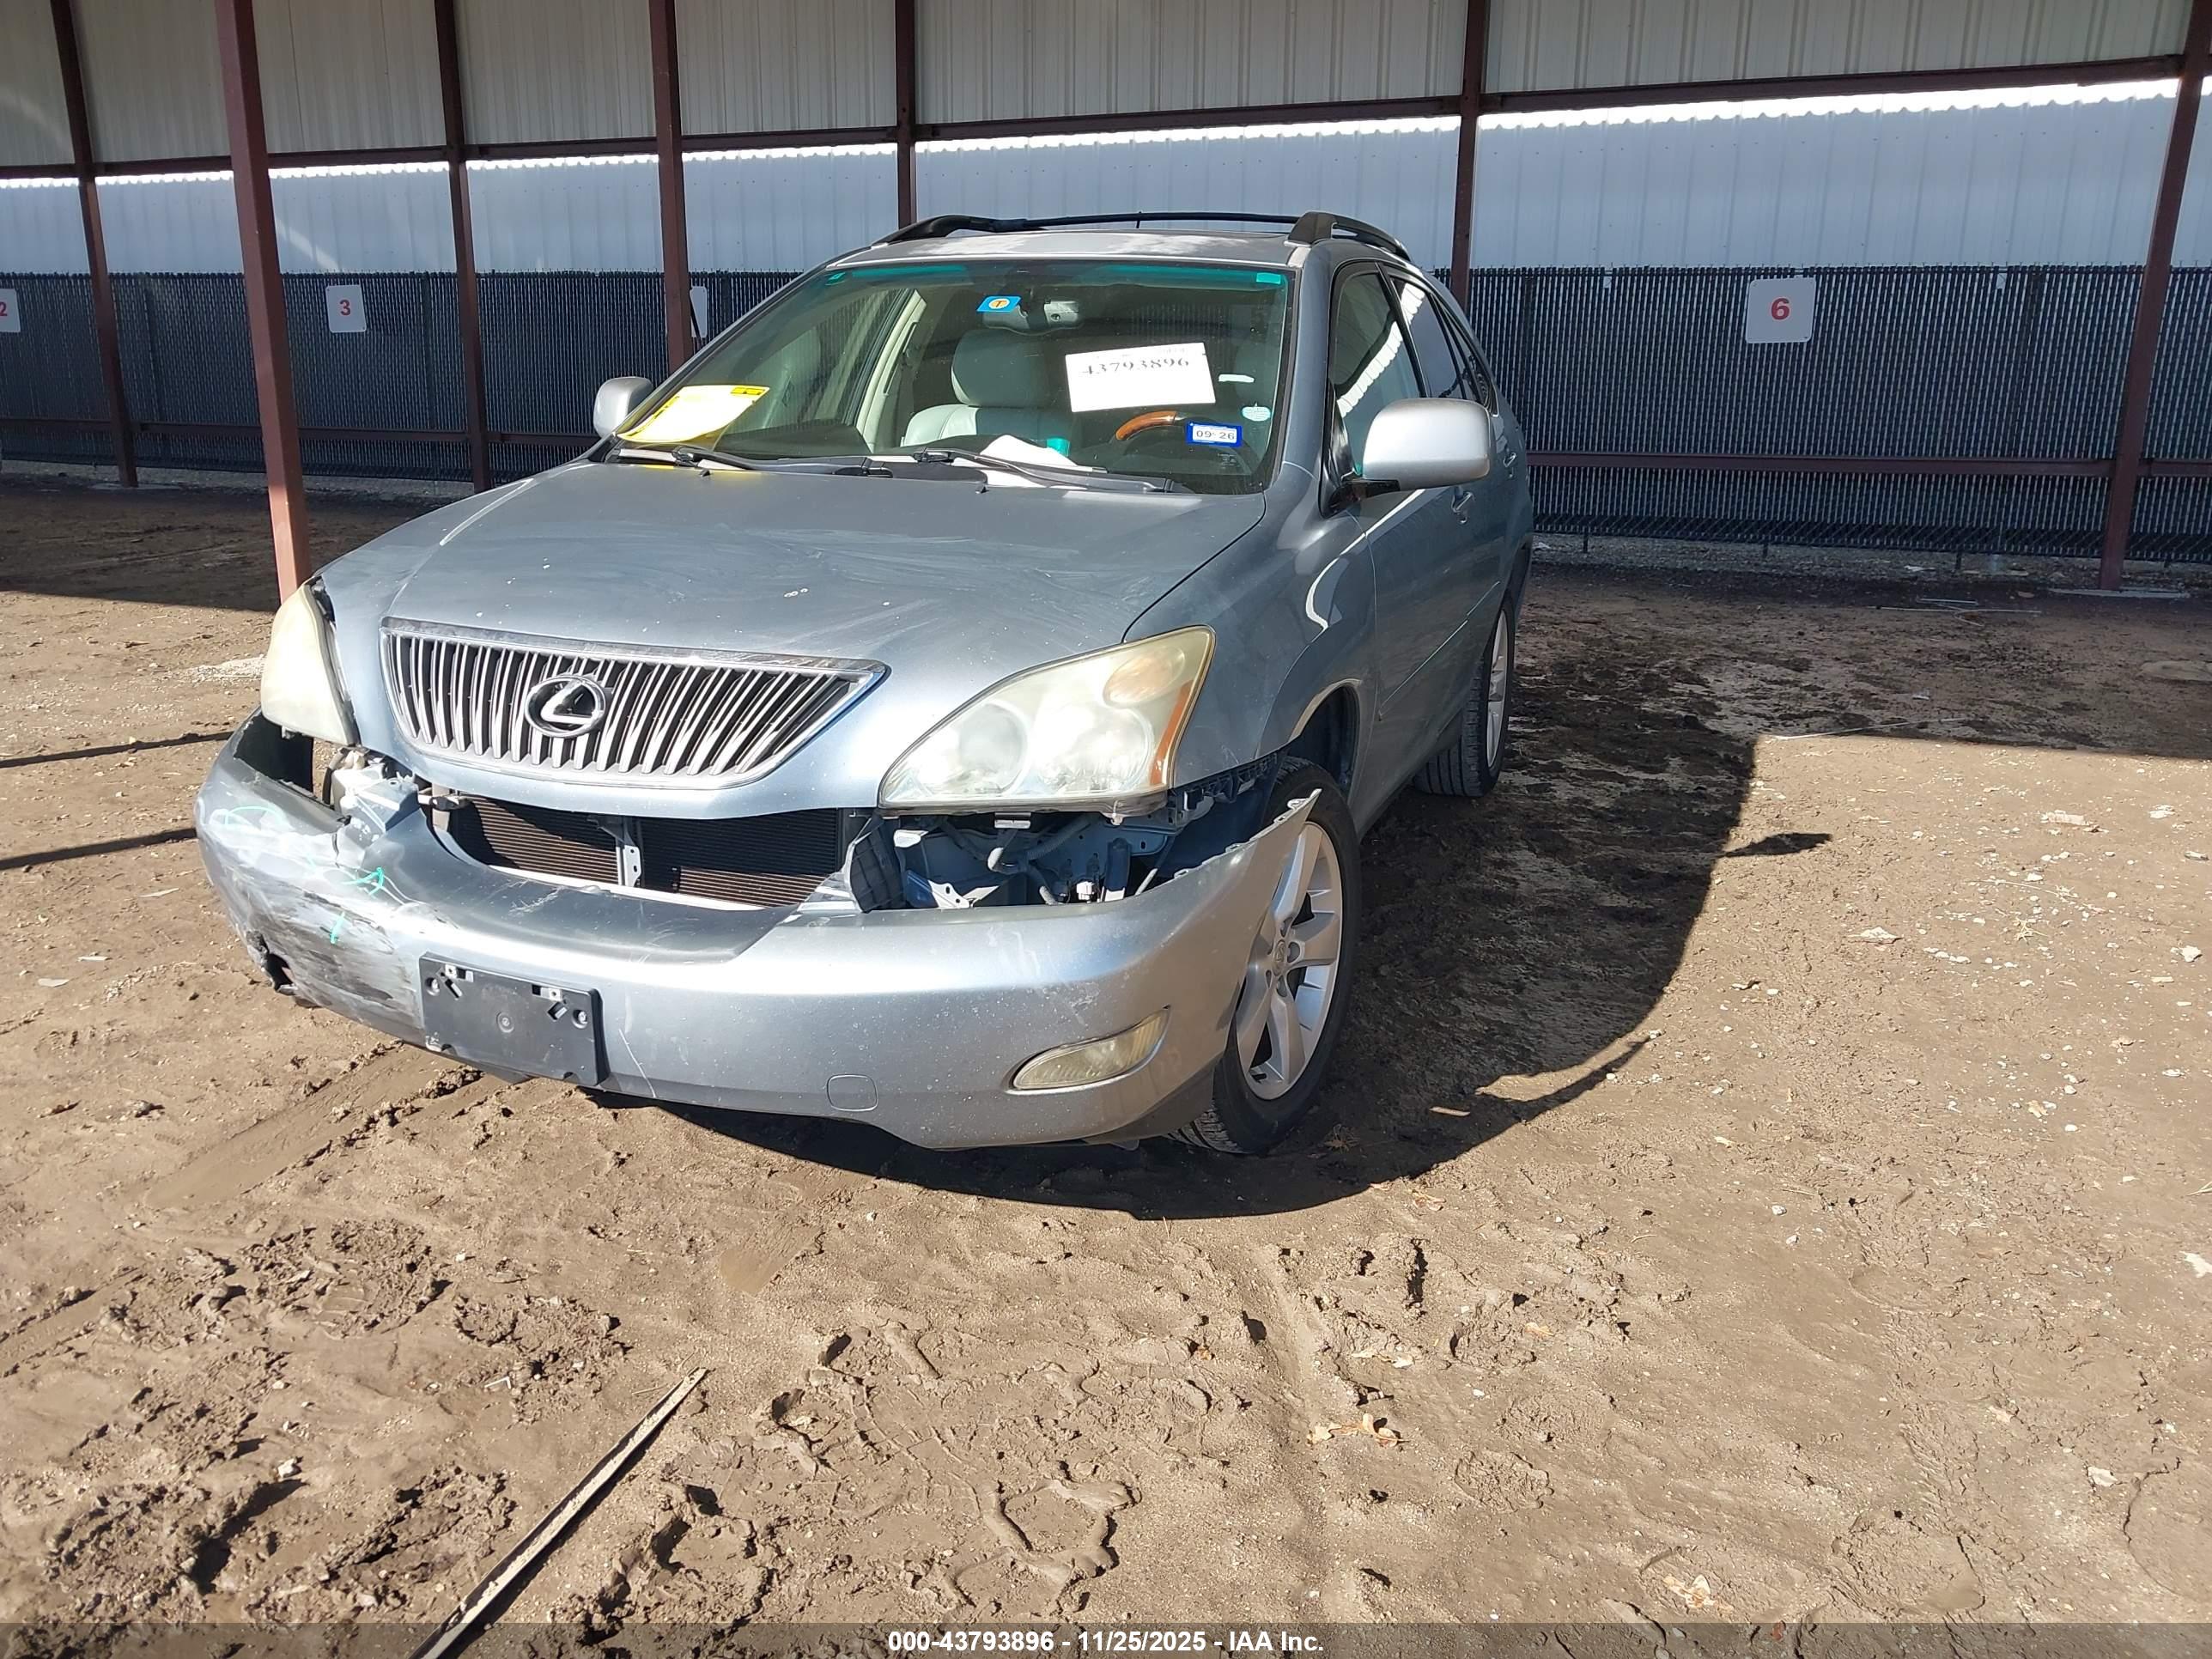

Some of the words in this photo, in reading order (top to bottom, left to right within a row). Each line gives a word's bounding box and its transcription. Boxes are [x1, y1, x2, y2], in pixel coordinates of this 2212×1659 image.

[0, 301, 8, 317] 2
[339, 299, 351, 316] 3
[1771, 297, 1790, 320] 6
[1082, 357, 1189, 375] 43793896
